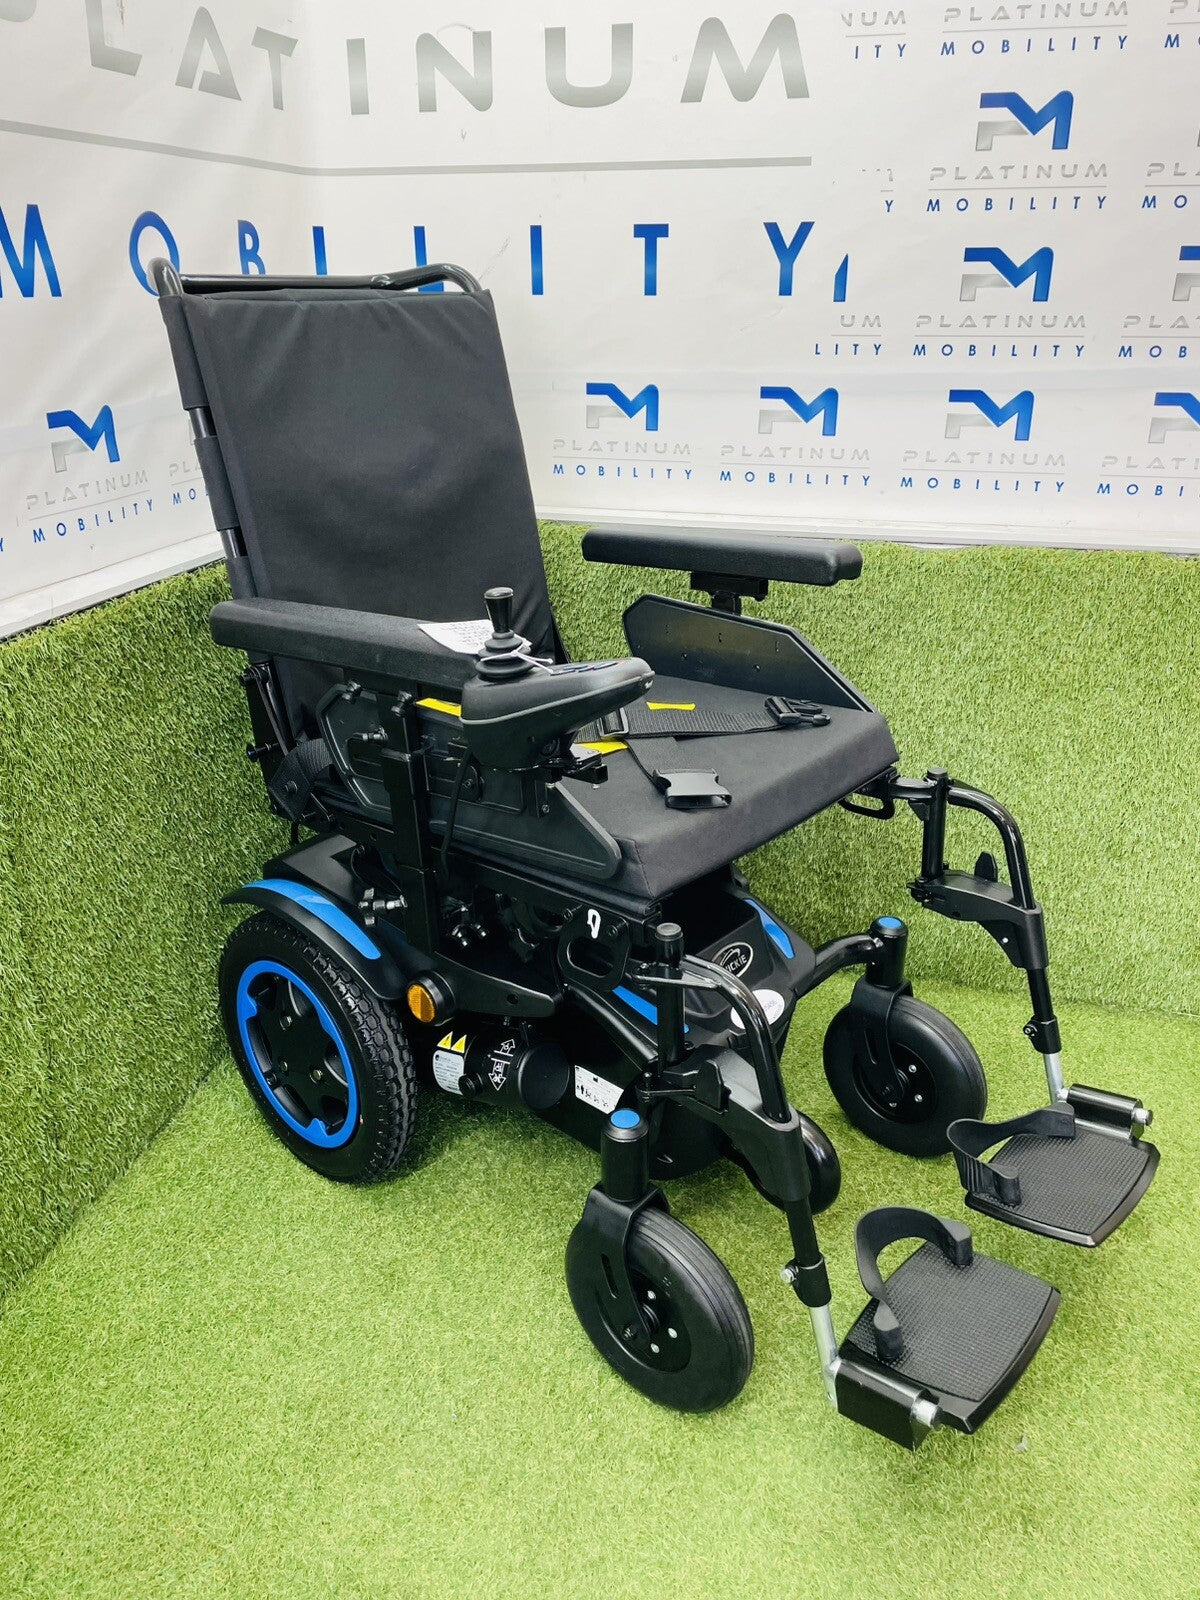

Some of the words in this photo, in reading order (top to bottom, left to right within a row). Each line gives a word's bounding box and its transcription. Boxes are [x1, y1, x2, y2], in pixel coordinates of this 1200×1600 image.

[943, 0, 1128, 23] PLATINUM
[940, 35, 1128, 56] MOBILITY
[929, 163, 1108, 181] PLATINUM
[926, 195, 1107, 212] MOBILITY
[915, 314, 1087, 329] PLATINUM
[912, 343, 1085, 358] MOBILITY
[553, 439, 692, 456] PLATINUM
[720, 444, 870, 462] PLATINUM
[902, 449, 1066, 468] PLATINUM
[553, 464, 692, 480] MOBILITY
[720, 470, 871, 487] MOBILITY
[26, 470, 149, 511] PLATINUM
[900, 476, 1064, 493] MOBILITY
[1096, 483, 1200, 498] MOBI
[172, 488, 209, 505] MO
[33, 499, 153, 544] MOBILITY
